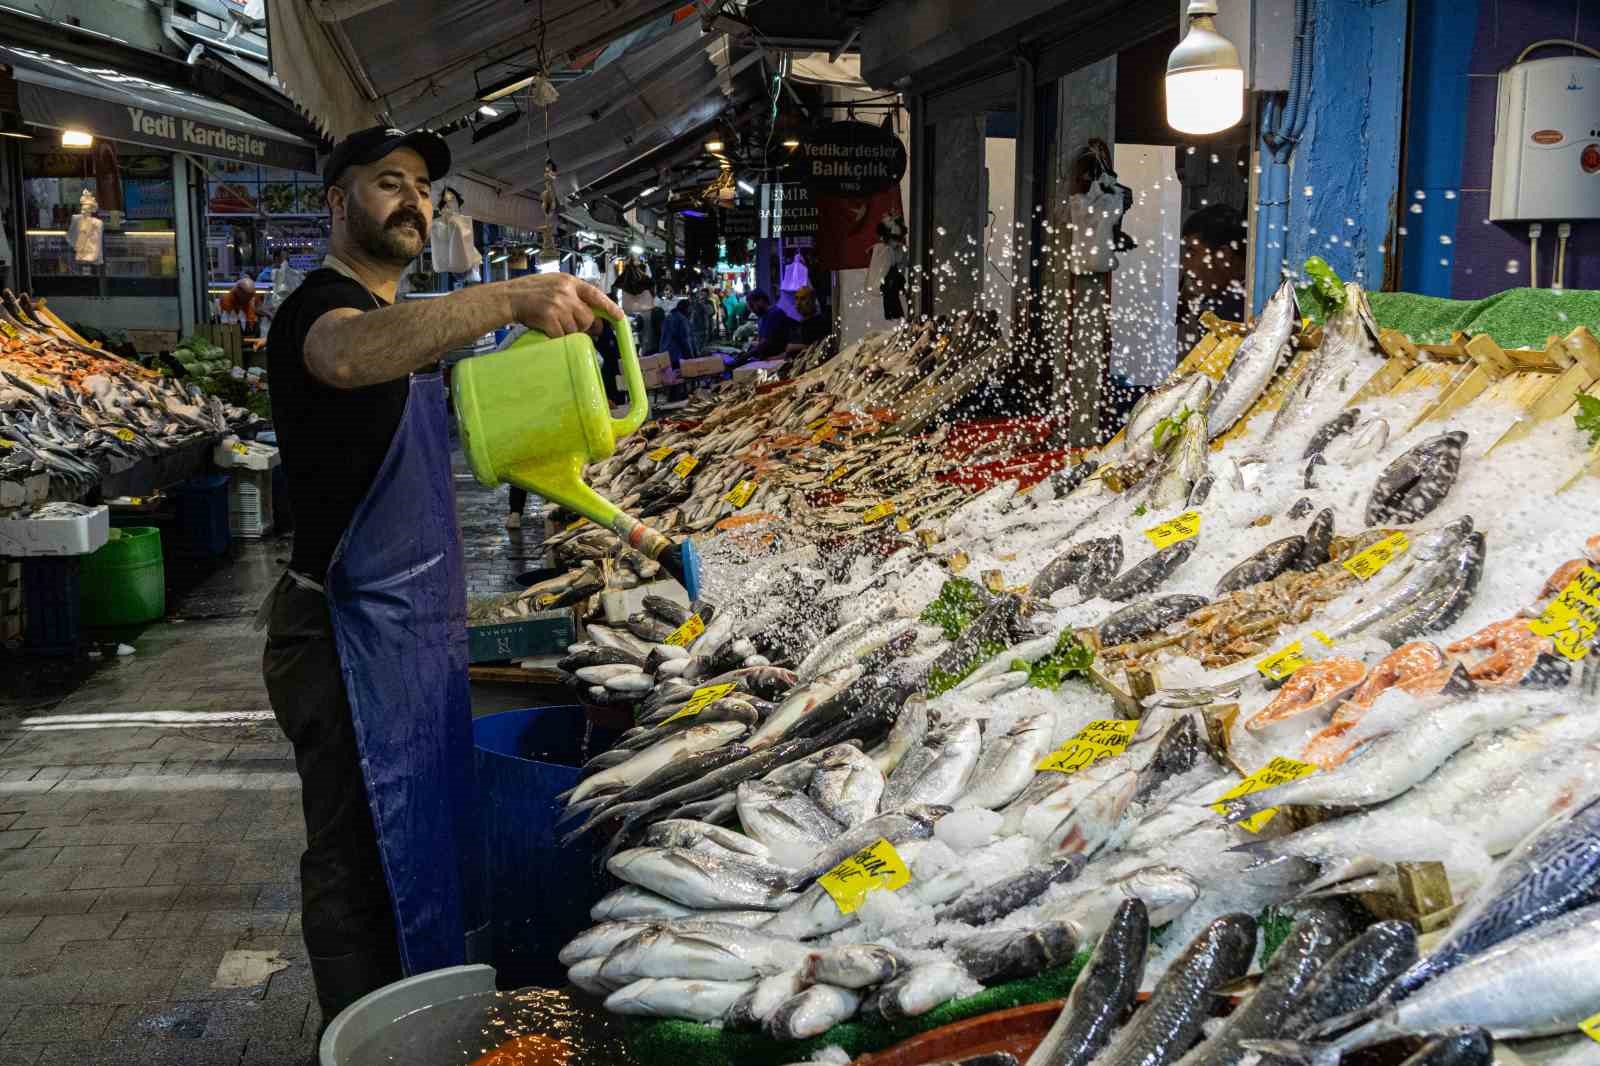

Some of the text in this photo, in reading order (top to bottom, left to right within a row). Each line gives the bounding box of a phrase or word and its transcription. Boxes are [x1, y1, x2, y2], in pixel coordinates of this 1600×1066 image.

[127, 106, 267, 158] Yedi Kardeşler
[811, 160, 889, 182] Balıkçılık
